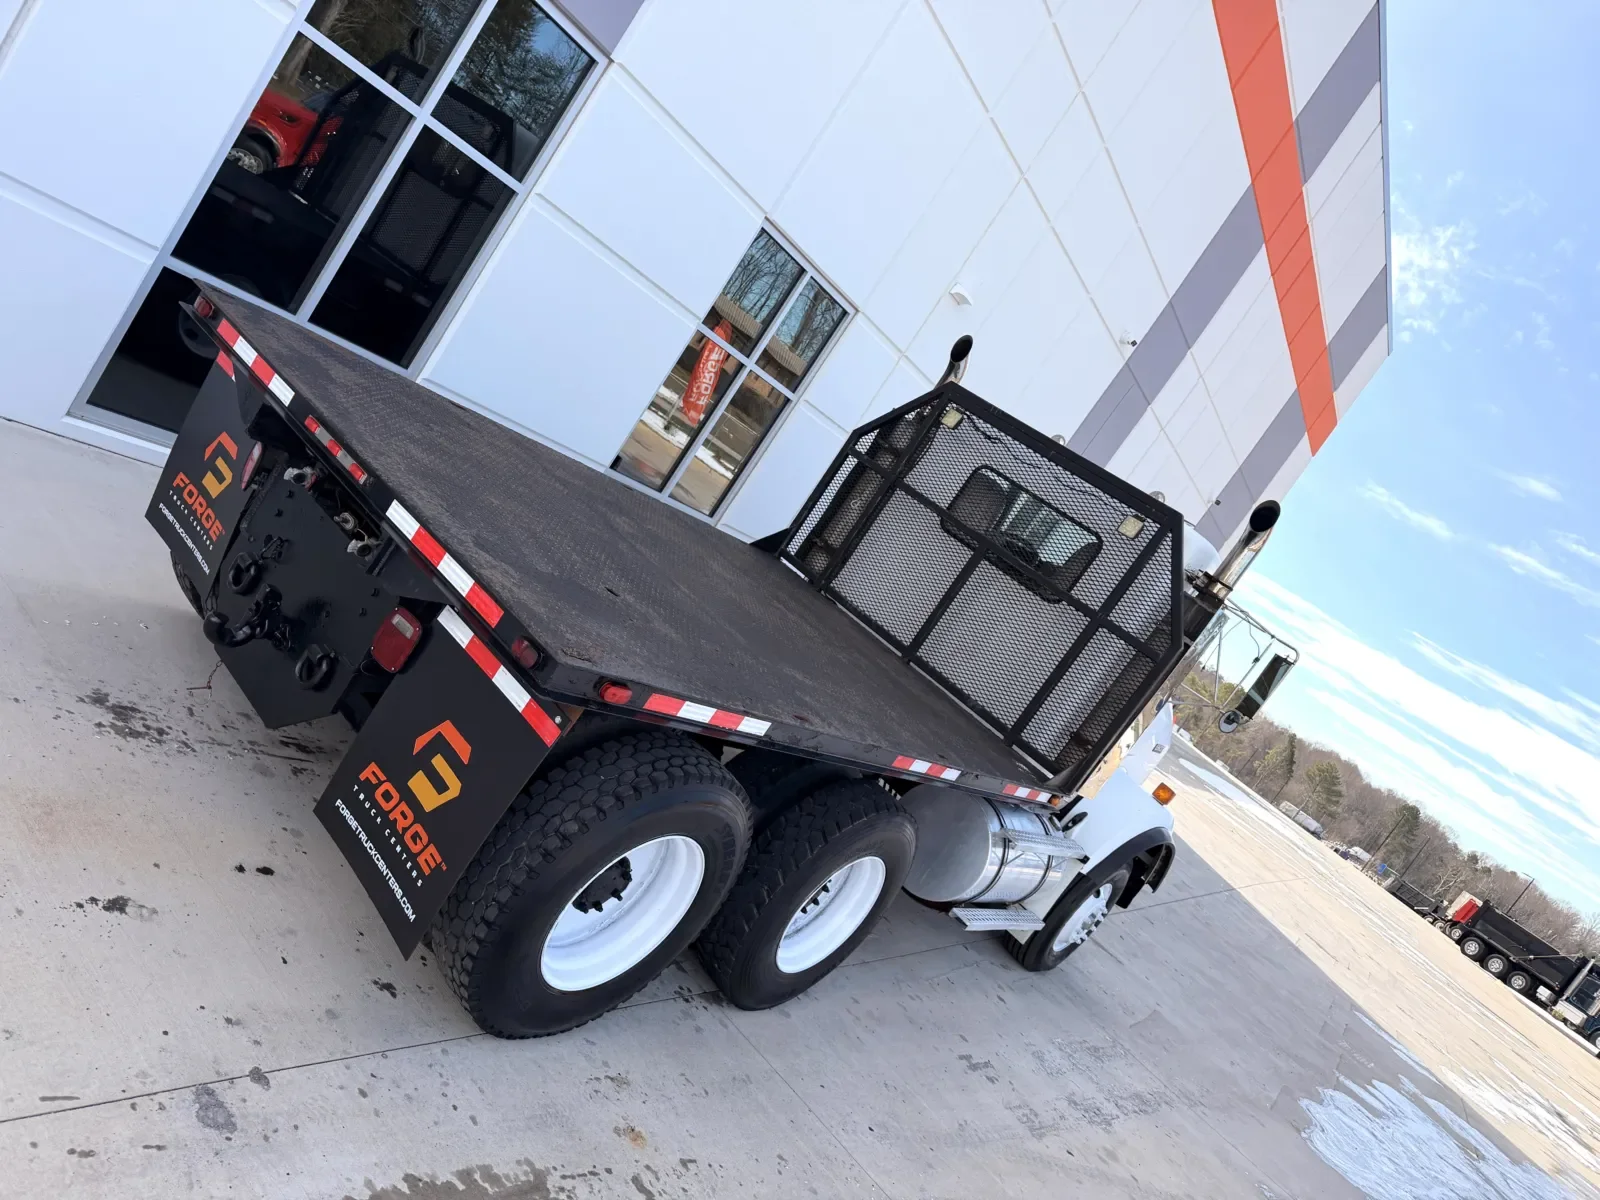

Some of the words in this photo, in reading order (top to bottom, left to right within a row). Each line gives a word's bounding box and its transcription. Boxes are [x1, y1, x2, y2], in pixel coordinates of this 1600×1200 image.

[158, 502, 211, 576] FORGETRUCKCENTERS.COM
[169, 490, 188, 515] TRUCK
[190, 516, 213, 551] CENTERS
[172, 471, 223, 542] FORGE
[334, 798, 417, 923] FORGETRUCKCENTERS.COM
[353, 784, 382, 825] TRUCK
[384, 828, 423, 887] CENTERS
[358, 761, 443, 876] FORGE
